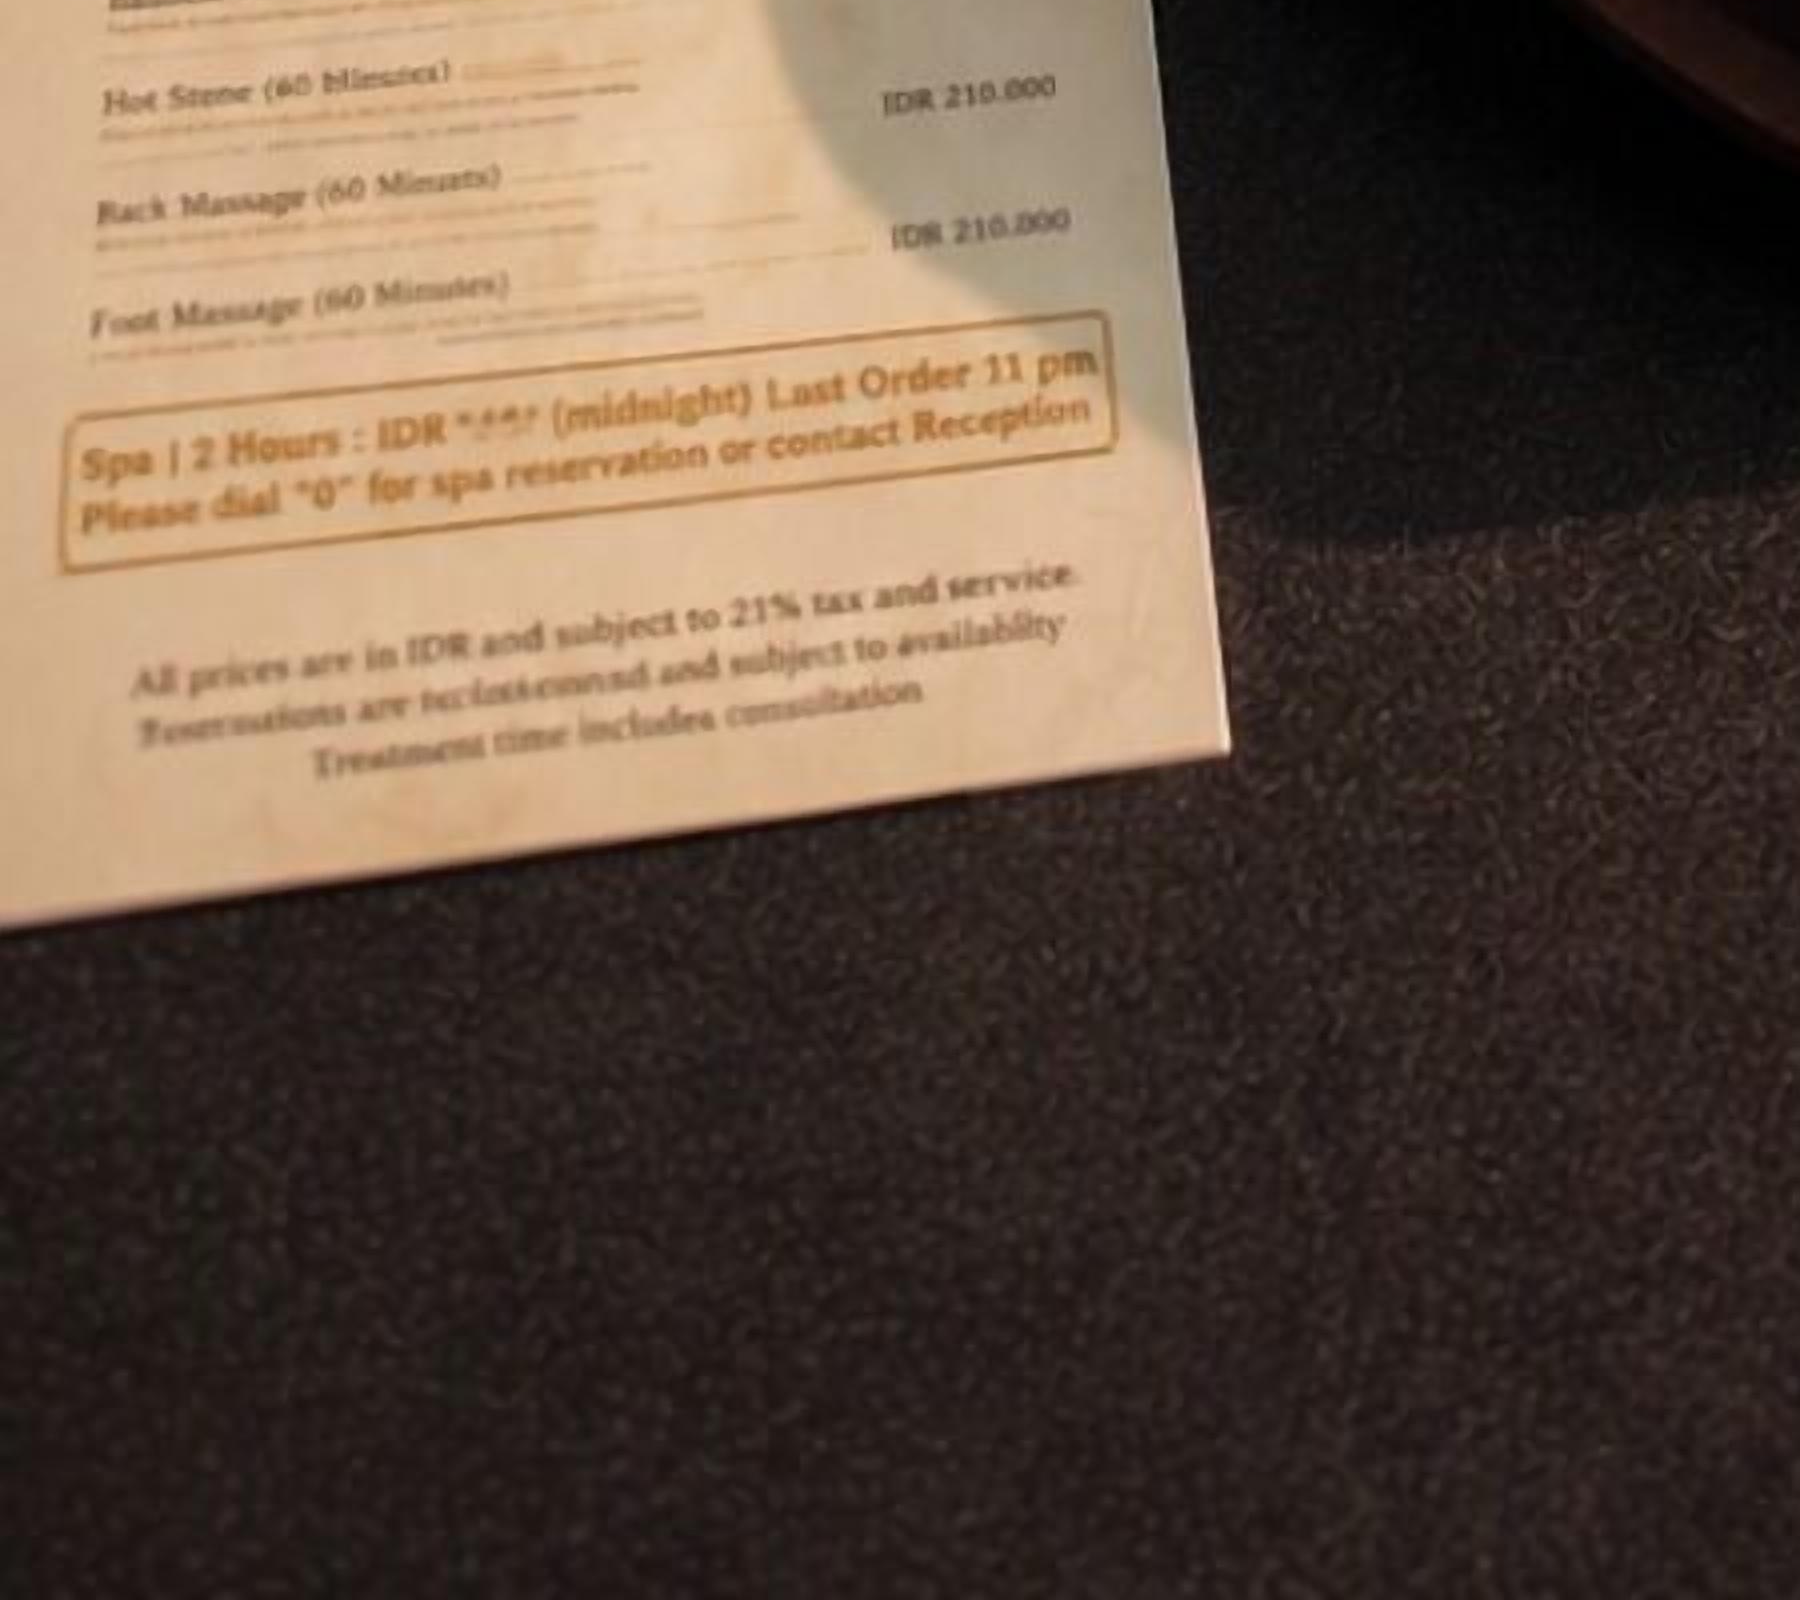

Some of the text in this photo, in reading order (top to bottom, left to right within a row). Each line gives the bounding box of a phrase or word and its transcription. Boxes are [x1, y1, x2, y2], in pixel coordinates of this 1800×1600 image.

[882, 74, 1057, 117] IDR 210.000
[892, 206, 1072, 251] IDR 210.000
[81, 445, 154, 488] Spa
[191, 435, 216, 471] 2
[228, 427, 341, 467] Hours
[377, 412, 446, 449] IDR
[553, 376, 752, 440] (midnight)
[767, 370, 846, 410] Last
[859, 354, 971, 399] Order
[985, 351, 1023, 385] 11
[1037, 346, 1099, 384] pm
[81, 497, 199, 536] Please
[213, 481, 281, 521] dial
[368, 466, 416, 504] for
[430, 465, 494, 506] spa
[504, 439, 709, 493] reservation
[720, 431, 758, 464] or
[767, 416, 901, 461] contact
[913, 391, 1090, 444] Reception
[129, 559, 1075, 700] All prices are in IDR and subject to 21% tax and service
[357, 697, 409, 723] are
[660, 649, 720, 686] and
[854, 637, 888, 664] to
